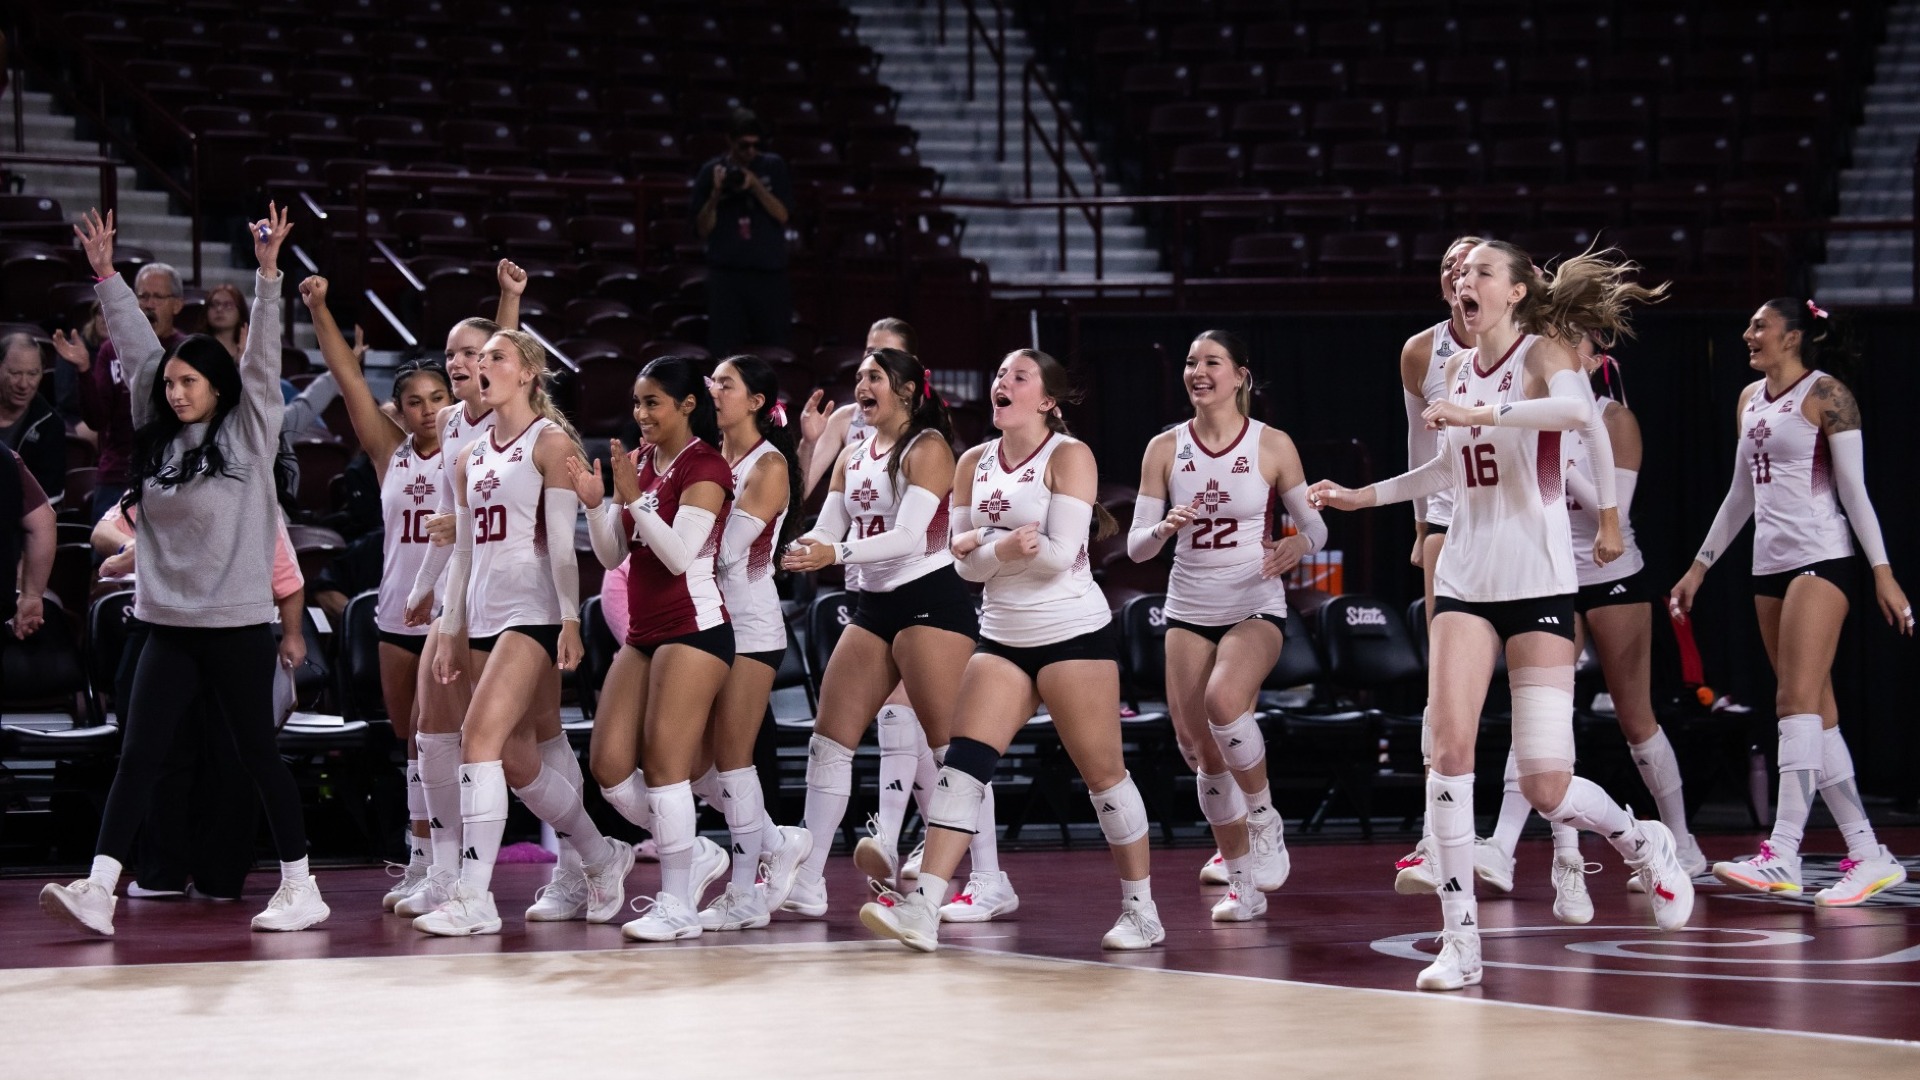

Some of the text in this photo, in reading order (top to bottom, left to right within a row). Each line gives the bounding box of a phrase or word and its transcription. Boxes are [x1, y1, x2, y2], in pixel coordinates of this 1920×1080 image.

[1231, 466, 1250, 474] USA
[1461, 444, 1499, 488] 16
[1753, 453, 1772, 484] 11
[475, 504, 507, 545] 30
[855, 515, 887, 539] 14
[1192, 517, 1238, 549] 22
[1346, 606, 1387, 626] State
